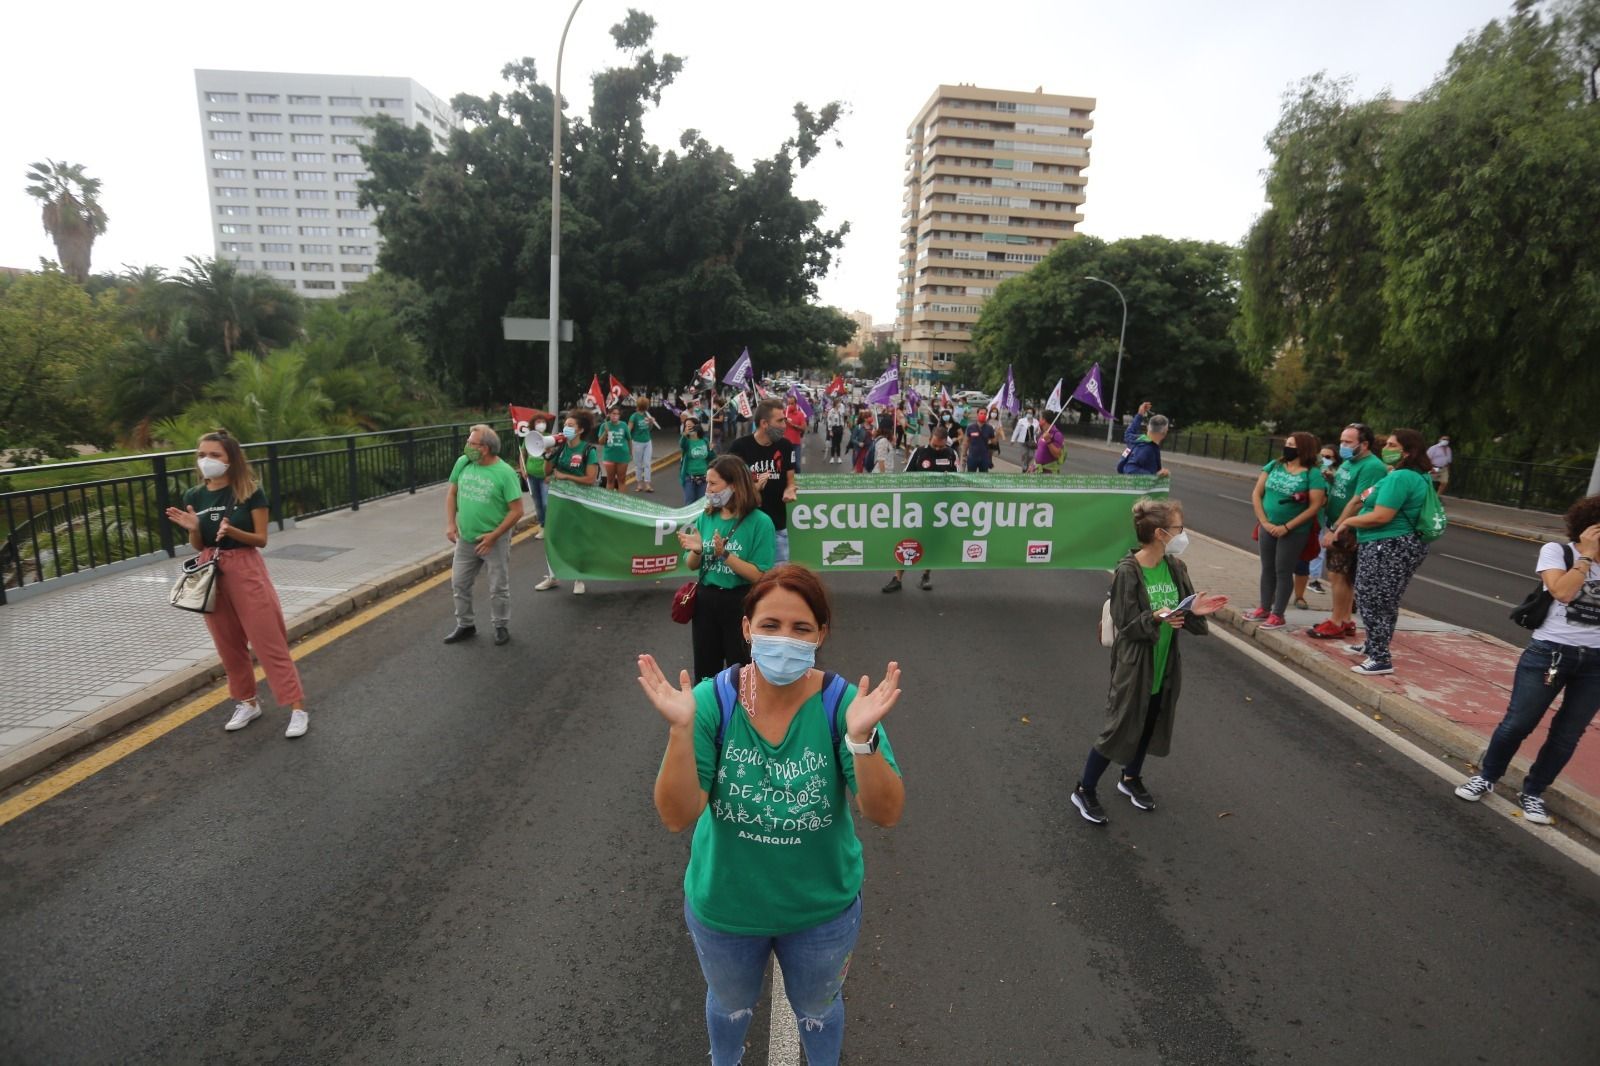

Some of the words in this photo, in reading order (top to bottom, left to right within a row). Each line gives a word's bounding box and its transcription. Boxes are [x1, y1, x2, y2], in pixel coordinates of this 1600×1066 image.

[791, 493, 923, 530] escuela
[932, 501, 1054, 537] segura
[632, 555, 678, 569] CCOO
[774, 753, 828, 780] PÚBLICA:
[729, 783, 754, 799] DE
[762, 788, 821, 807] TOD@S
[714, 806, 764, 826] PARA
[769, 813, 833, 832] TOD@S
